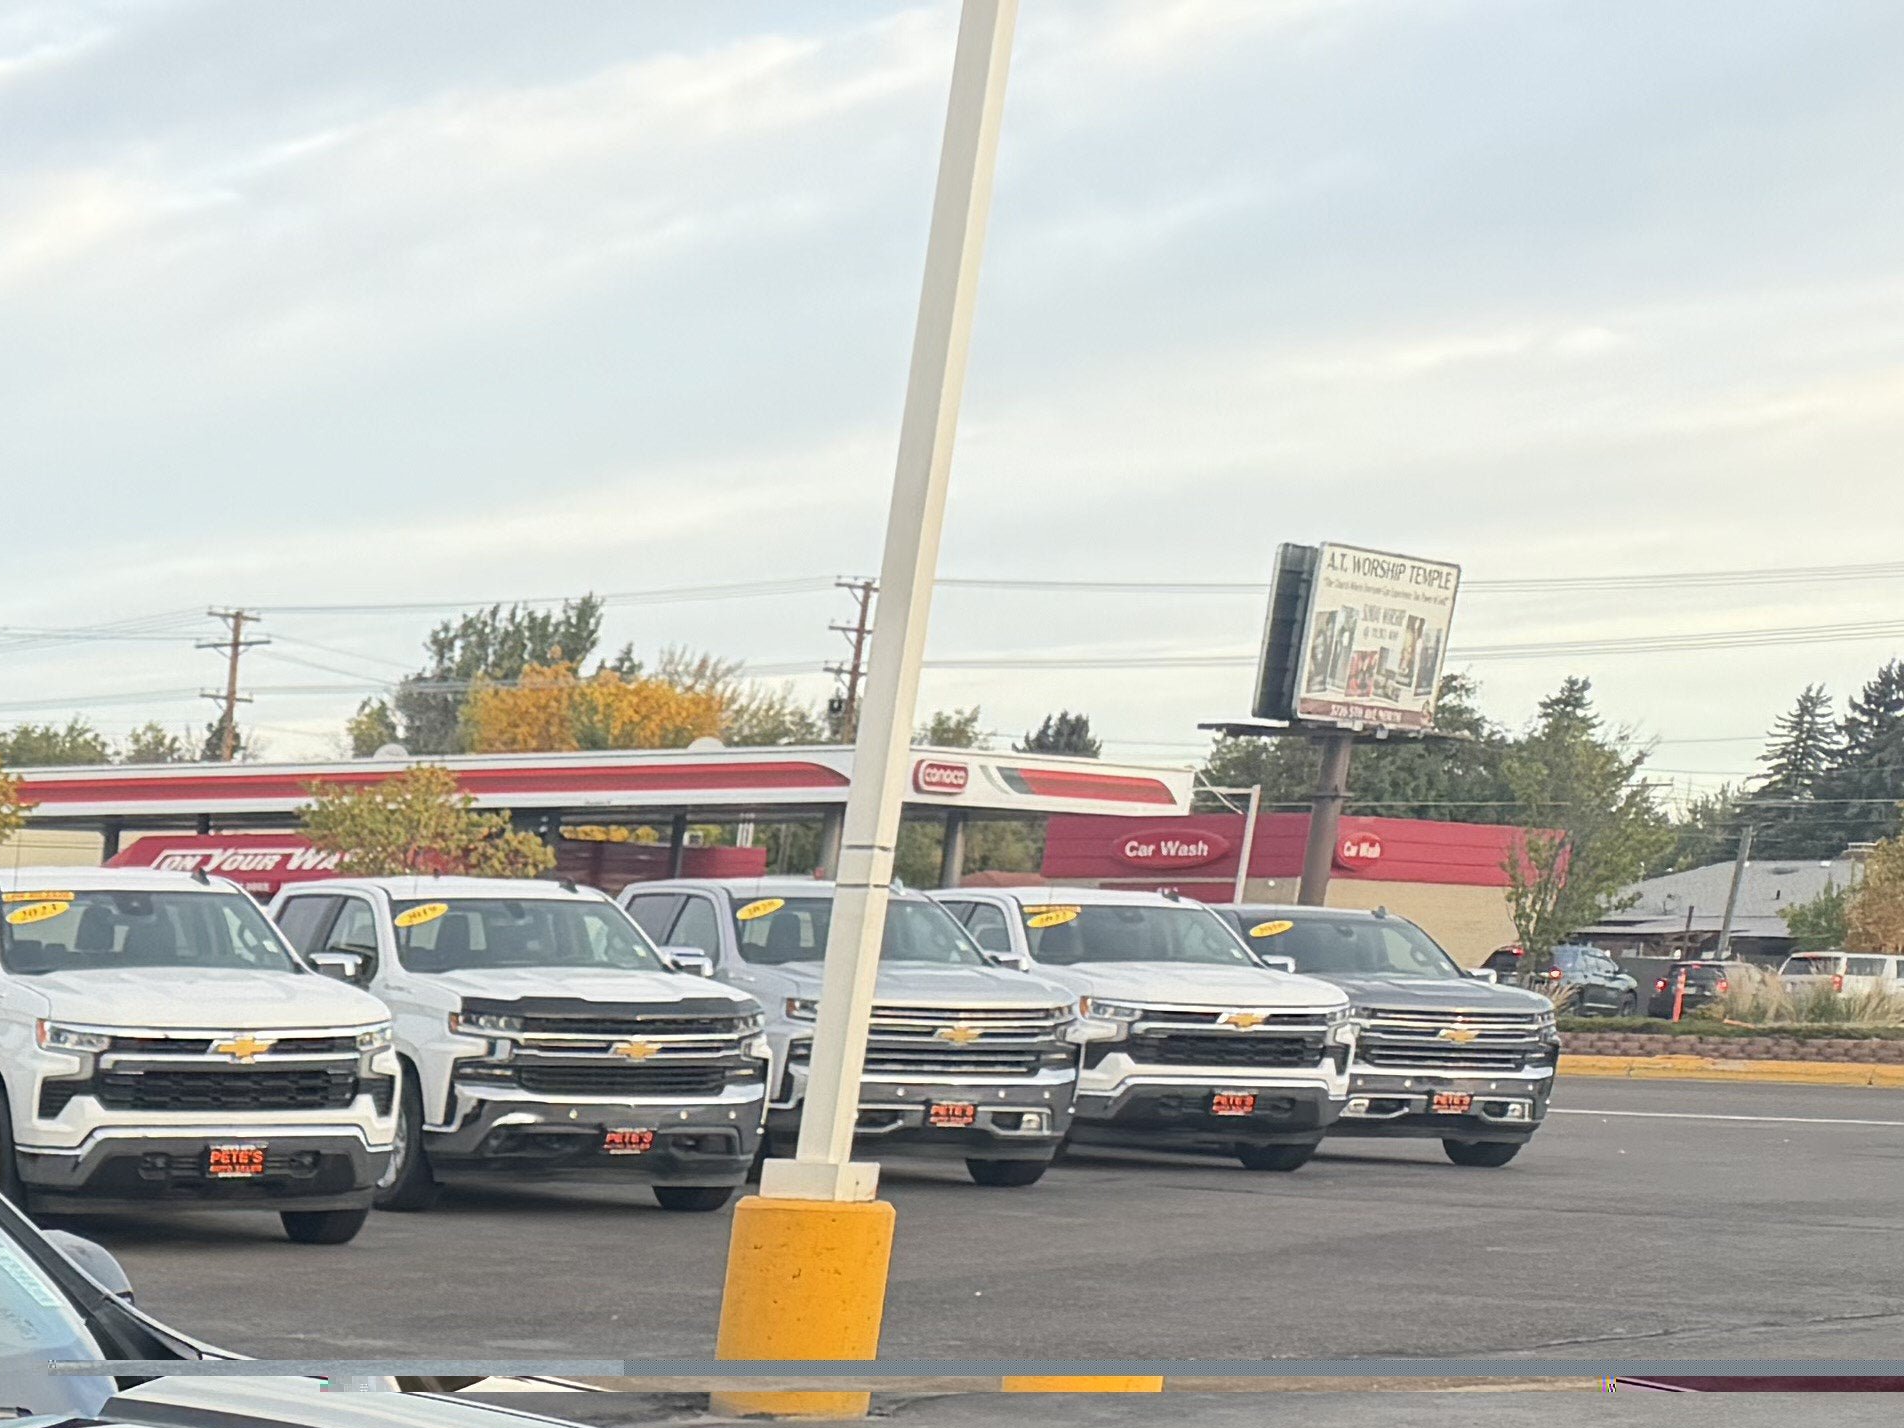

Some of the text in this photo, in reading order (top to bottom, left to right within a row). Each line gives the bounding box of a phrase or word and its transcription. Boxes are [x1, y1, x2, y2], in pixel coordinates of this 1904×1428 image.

[1352, 555, 1406, 581] WORSHIP
[1409, 565, 1452, 590] TEMPLE
[925, 767, 966, 786] conoco
[1124, 839, 1209, 857] Car Wash
[203, 848, 283, 872] YOUR
[210, 1149, 264, 1164] PETE'S
